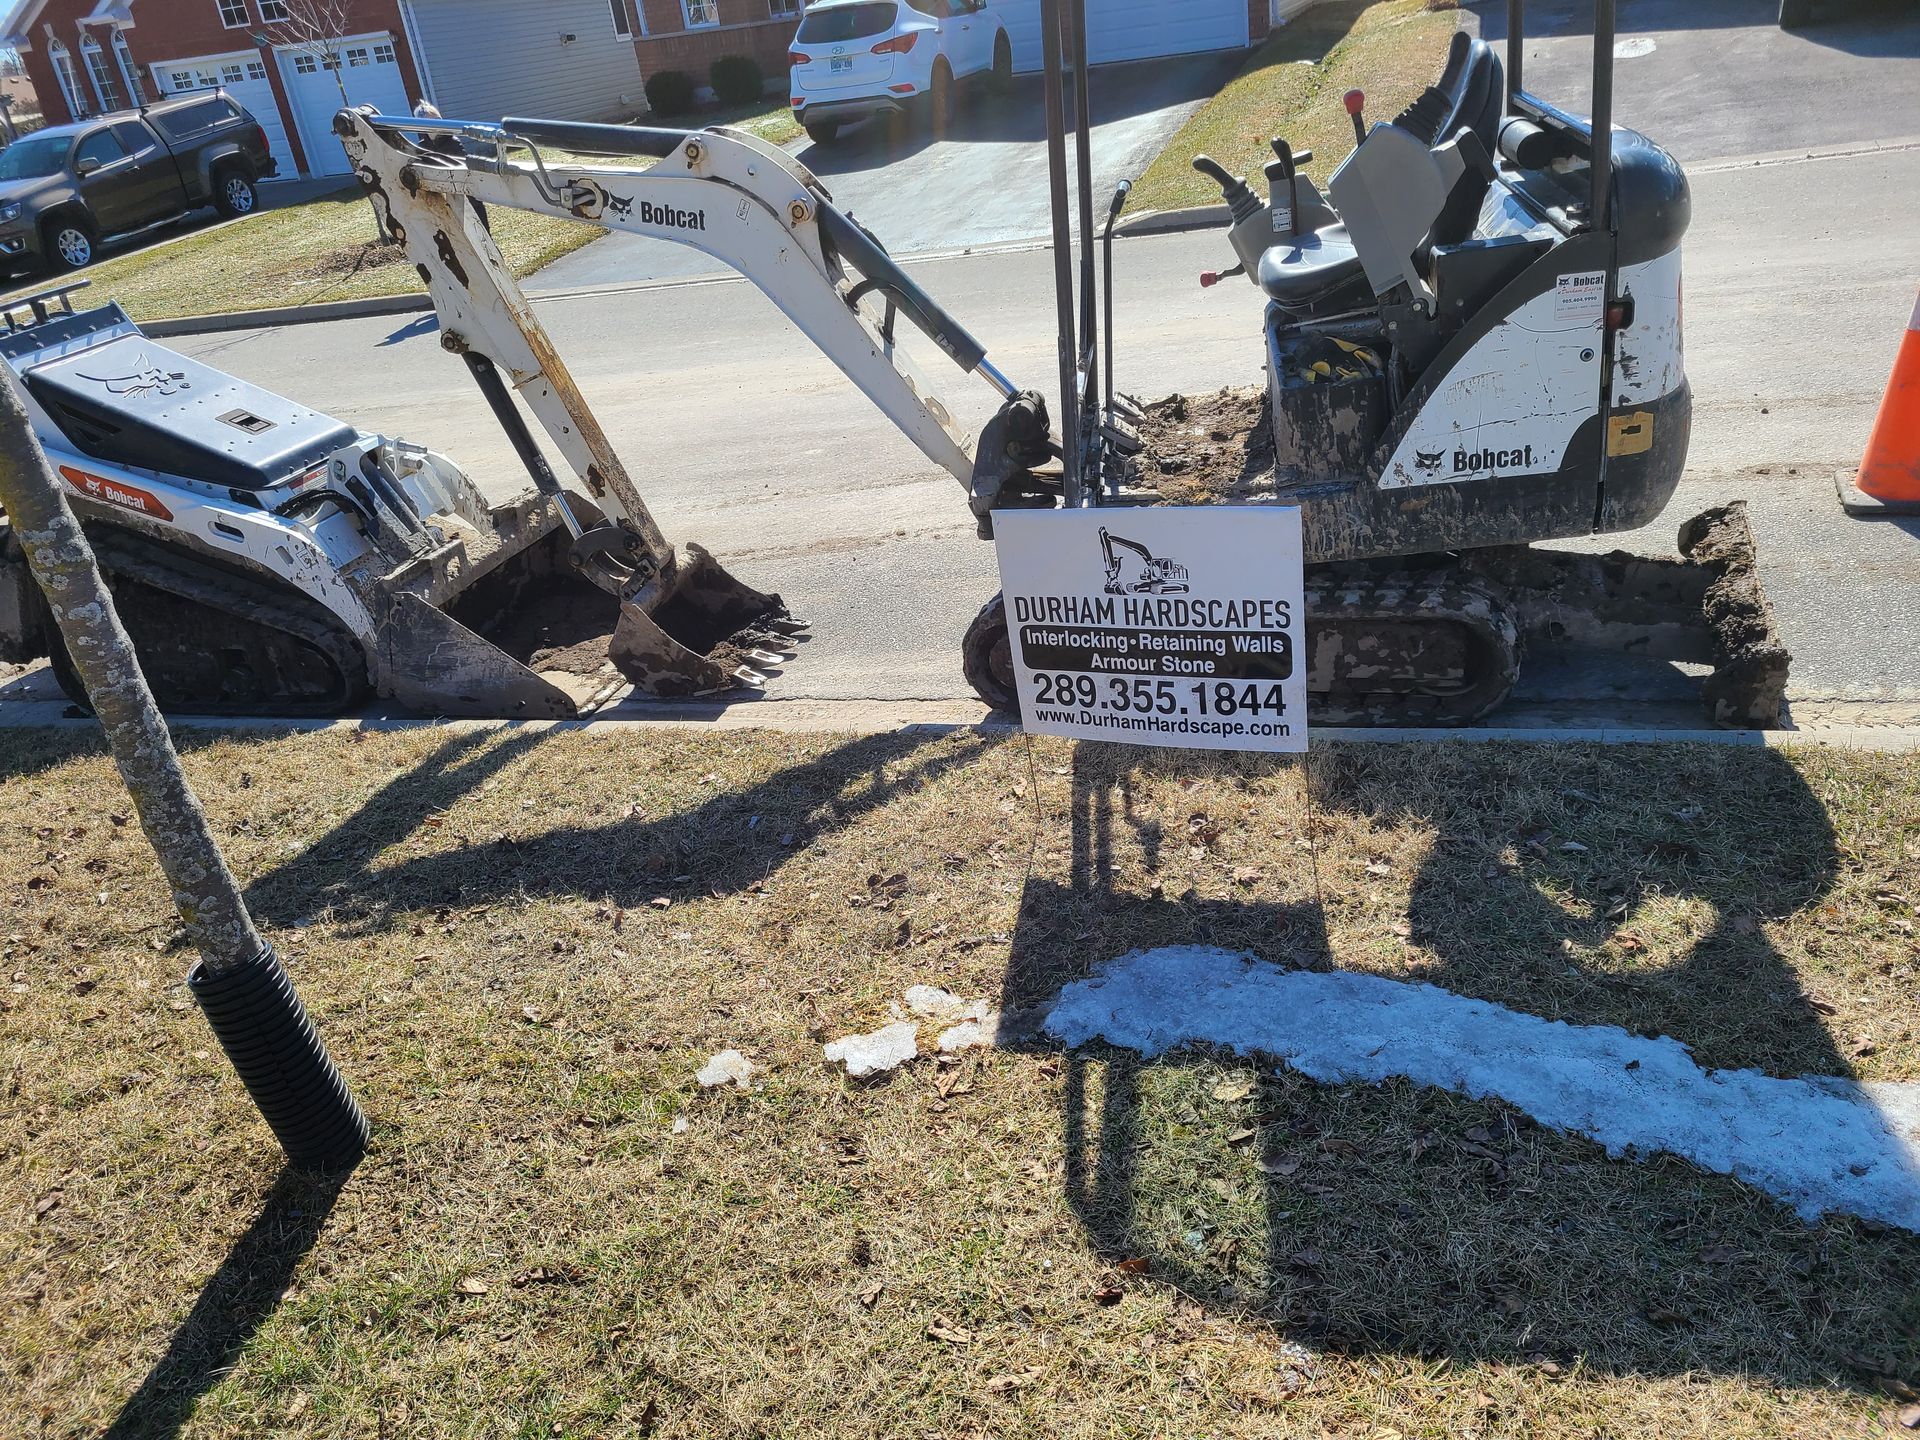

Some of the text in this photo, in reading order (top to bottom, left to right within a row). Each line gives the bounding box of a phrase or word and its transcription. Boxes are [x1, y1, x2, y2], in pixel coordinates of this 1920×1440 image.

[641, 201, 706, 231] Bobcat
[1573, 274, 1604, 287] Bobcat
[1453, 444, 1532, 473] Bobcat
[104, 486, 146, 511] Bobcat
[1014, 596, 1291, 629] DURHAM HARDSCAPES
[1026, 628, 1284, 656] Interlocking Retaining Walls
[1091, 653, 1216, 674] Armour Stone
[1033, 673, 1287, 716] 289.355.1844
[1035, 709, 1290, 738] www.DurhamHardscape.com
